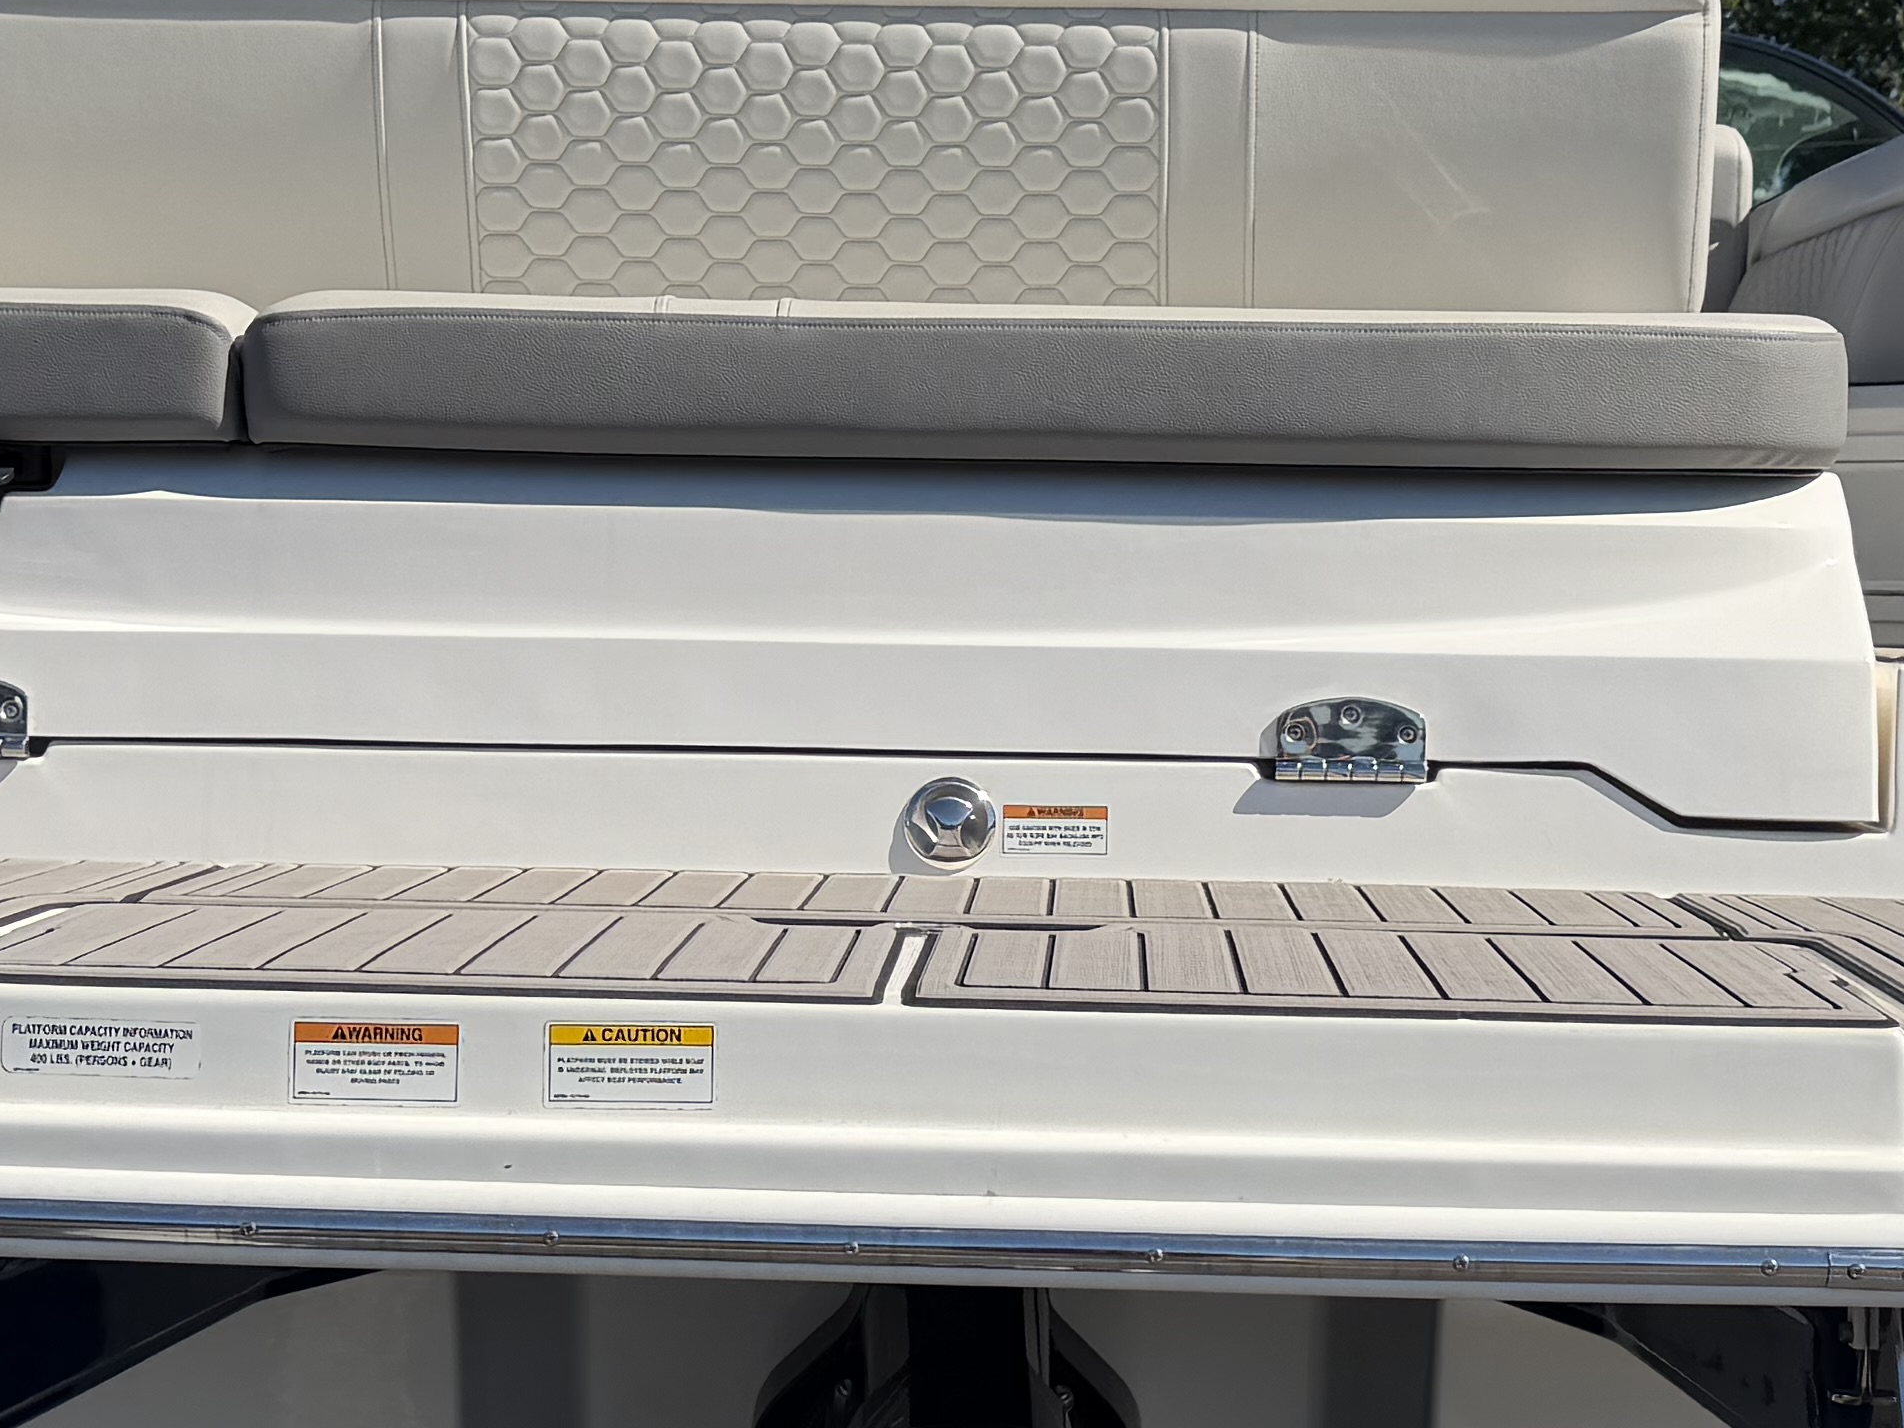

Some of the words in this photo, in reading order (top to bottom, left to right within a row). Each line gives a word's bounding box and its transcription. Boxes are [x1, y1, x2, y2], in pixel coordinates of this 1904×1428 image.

[12, 1023, 67, 1035] PLATFORM
[69, 1025, 120, 1037] CAPACITY
[123, 1027, 193, 1039] INFORMATION
[347, 1026, 423, 1042] WARNING
[601, 1028, 683, 1043] CAUTION
[29, 1038, 78, 1050] MAXIMUM
[81, 1039, 121, 1052] WEIGHT
[124, 1041, 175, 1053] CAPACITY
